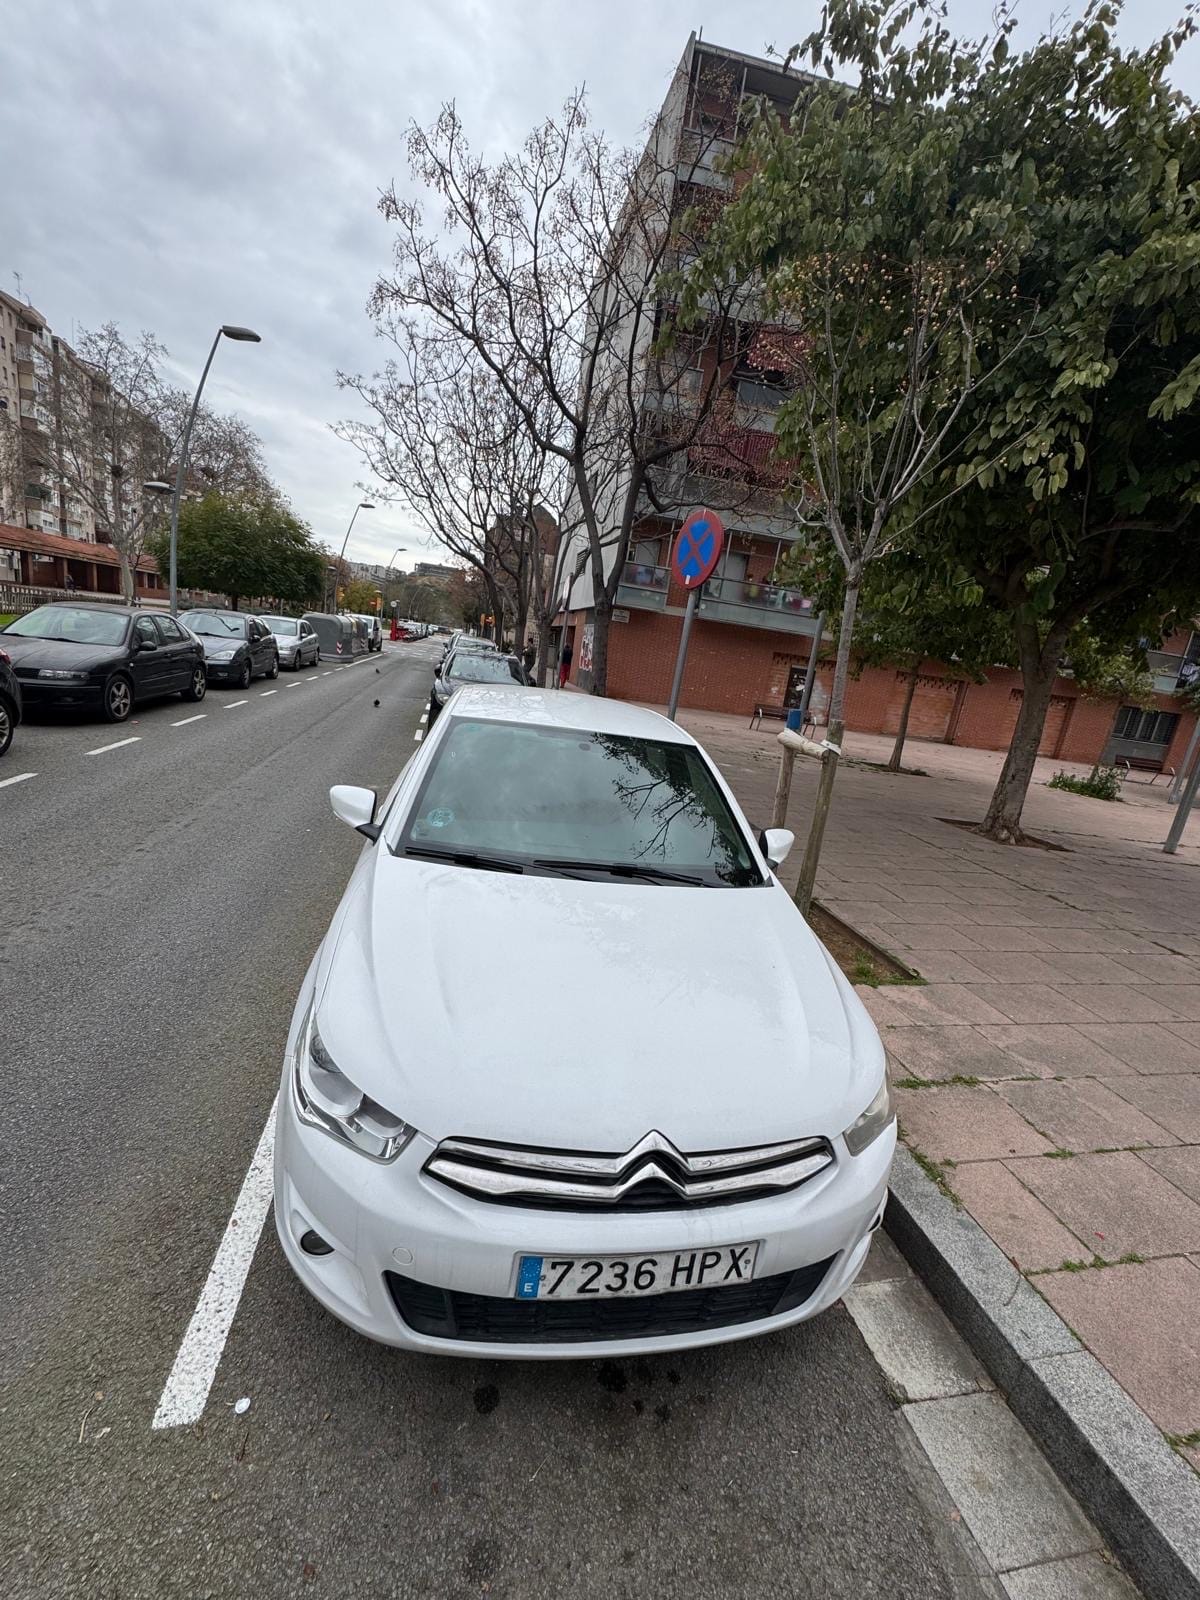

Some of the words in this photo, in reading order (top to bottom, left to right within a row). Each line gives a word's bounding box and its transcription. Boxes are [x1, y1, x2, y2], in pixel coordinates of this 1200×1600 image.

[524, 1283, 533, 1292] E
[547, 1258, 658, 1294] 7236
[670, 1247, 749, 1287] HPX
